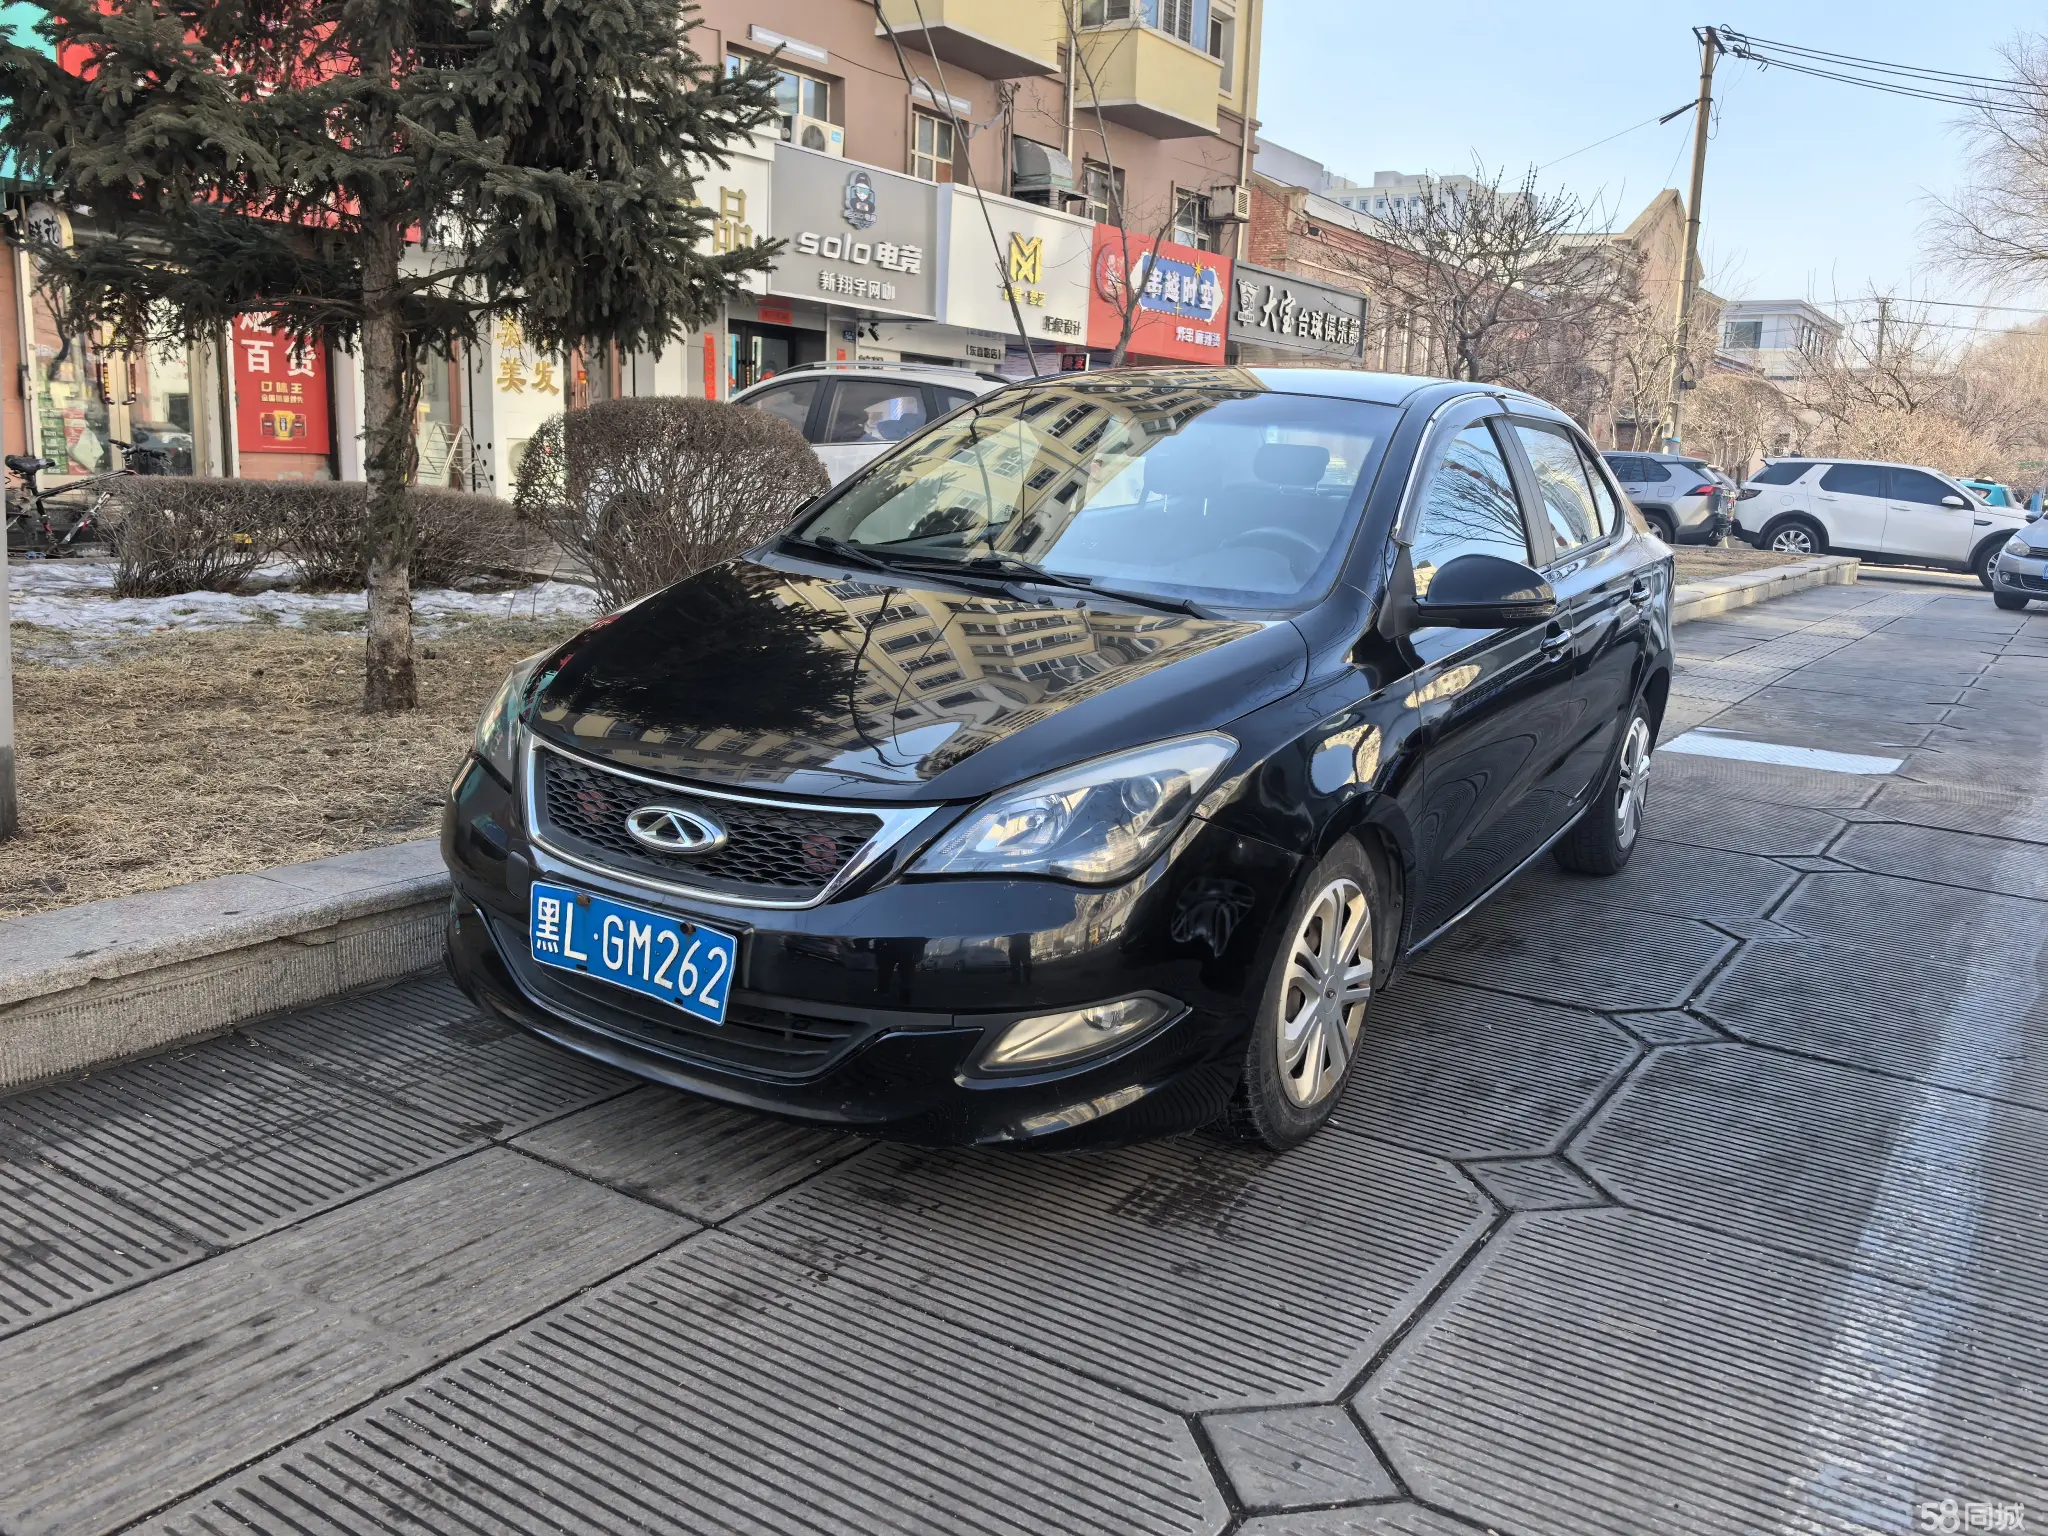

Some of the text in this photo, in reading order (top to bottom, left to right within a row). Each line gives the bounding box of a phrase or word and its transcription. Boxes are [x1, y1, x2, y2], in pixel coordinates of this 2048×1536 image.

[819, 267, 896, 301] 新翔宇网咖
[241, 339, 316, 377] 百货
[260, 380, 303, 394] 口味王
[496, 357, 560, 396] 美发
